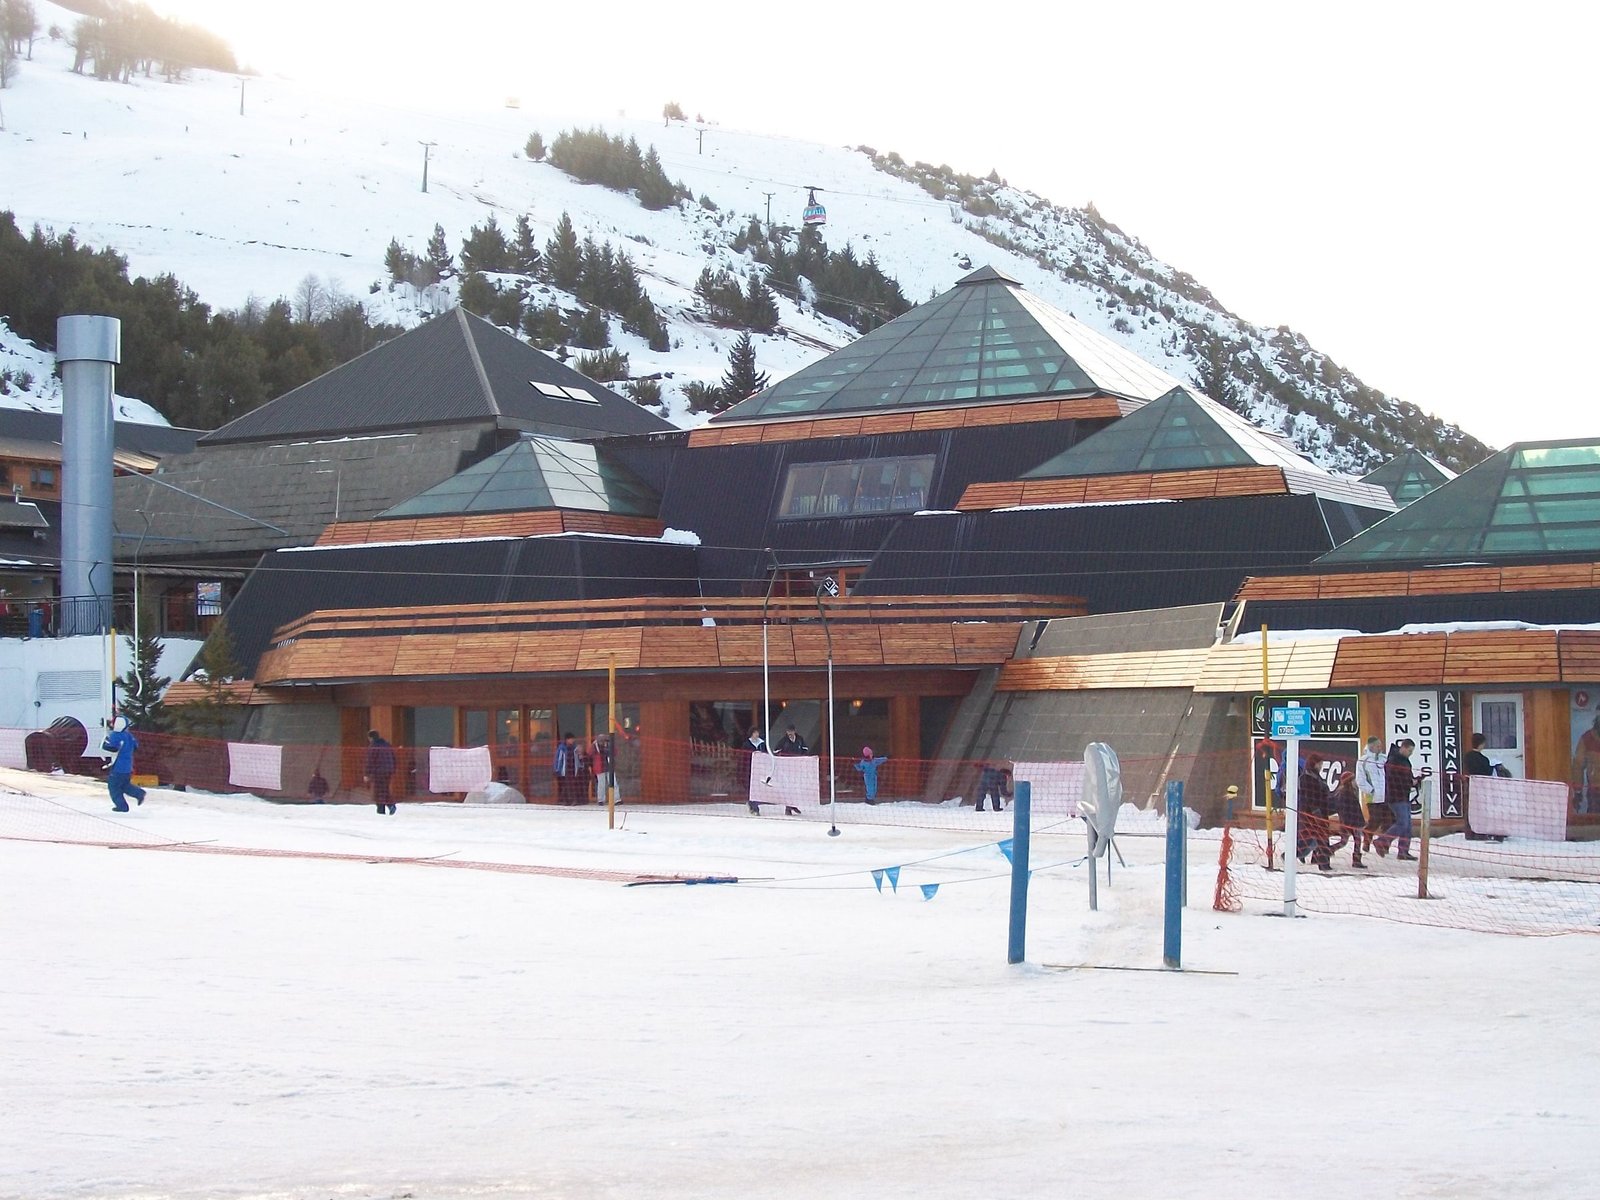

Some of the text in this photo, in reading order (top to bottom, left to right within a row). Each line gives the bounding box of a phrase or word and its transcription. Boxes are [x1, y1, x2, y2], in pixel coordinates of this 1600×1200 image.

[1310, 707, 1354, 721] NATIVA
[1337, 724, 1354, 732] SKI
[1418, 699, 1432, 777] SPORTS
[1444, 692, 1459, 815] ALTERNATIVA
